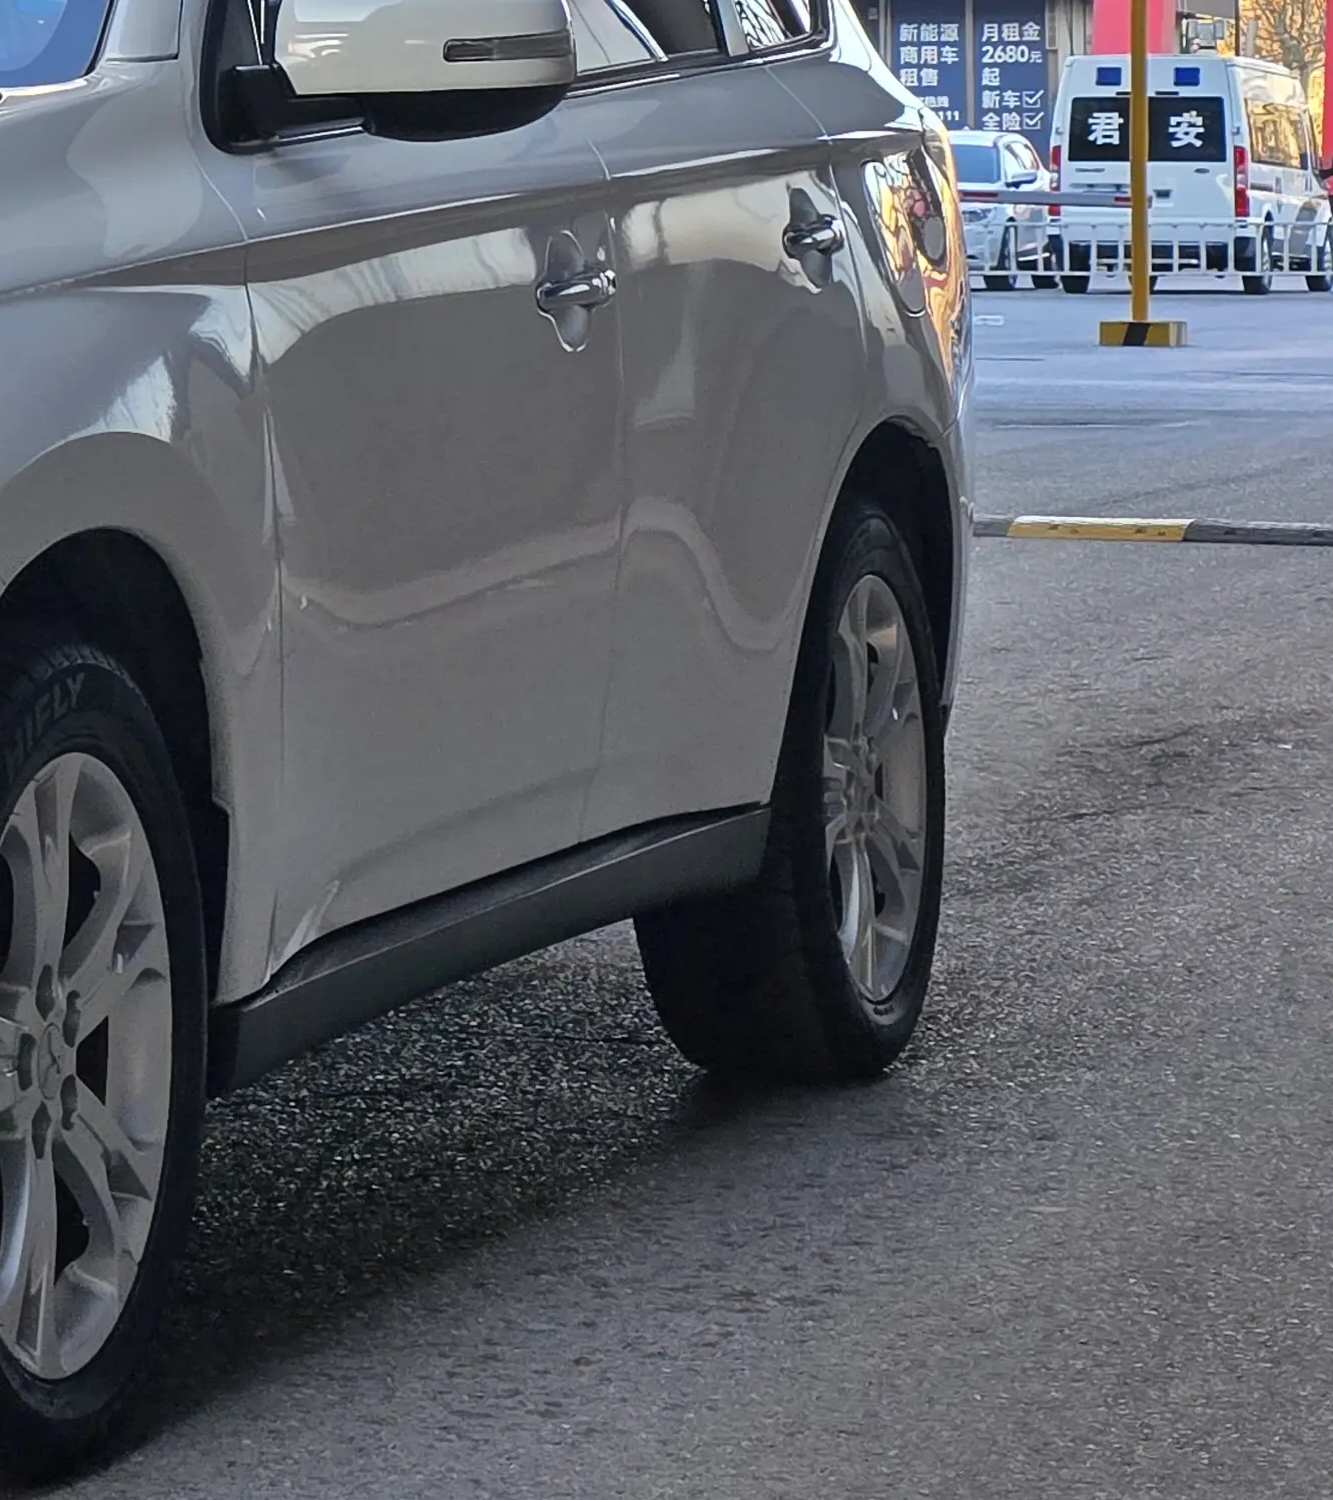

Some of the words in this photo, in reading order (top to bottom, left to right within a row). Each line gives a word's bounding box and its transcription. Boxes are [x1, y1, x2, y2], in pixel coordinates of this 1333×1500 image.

[899, 23, 959, 42] 新能源
[981, 21, 1041, 42] 月租金
[900, 46, 959, 64] 商用车
[900, 68, 938, 87] 租售
[981, 67, 1000, 86] 起
[981, 90, 1021, 109] 新车
[982, 112, 1021, 131] 全险
